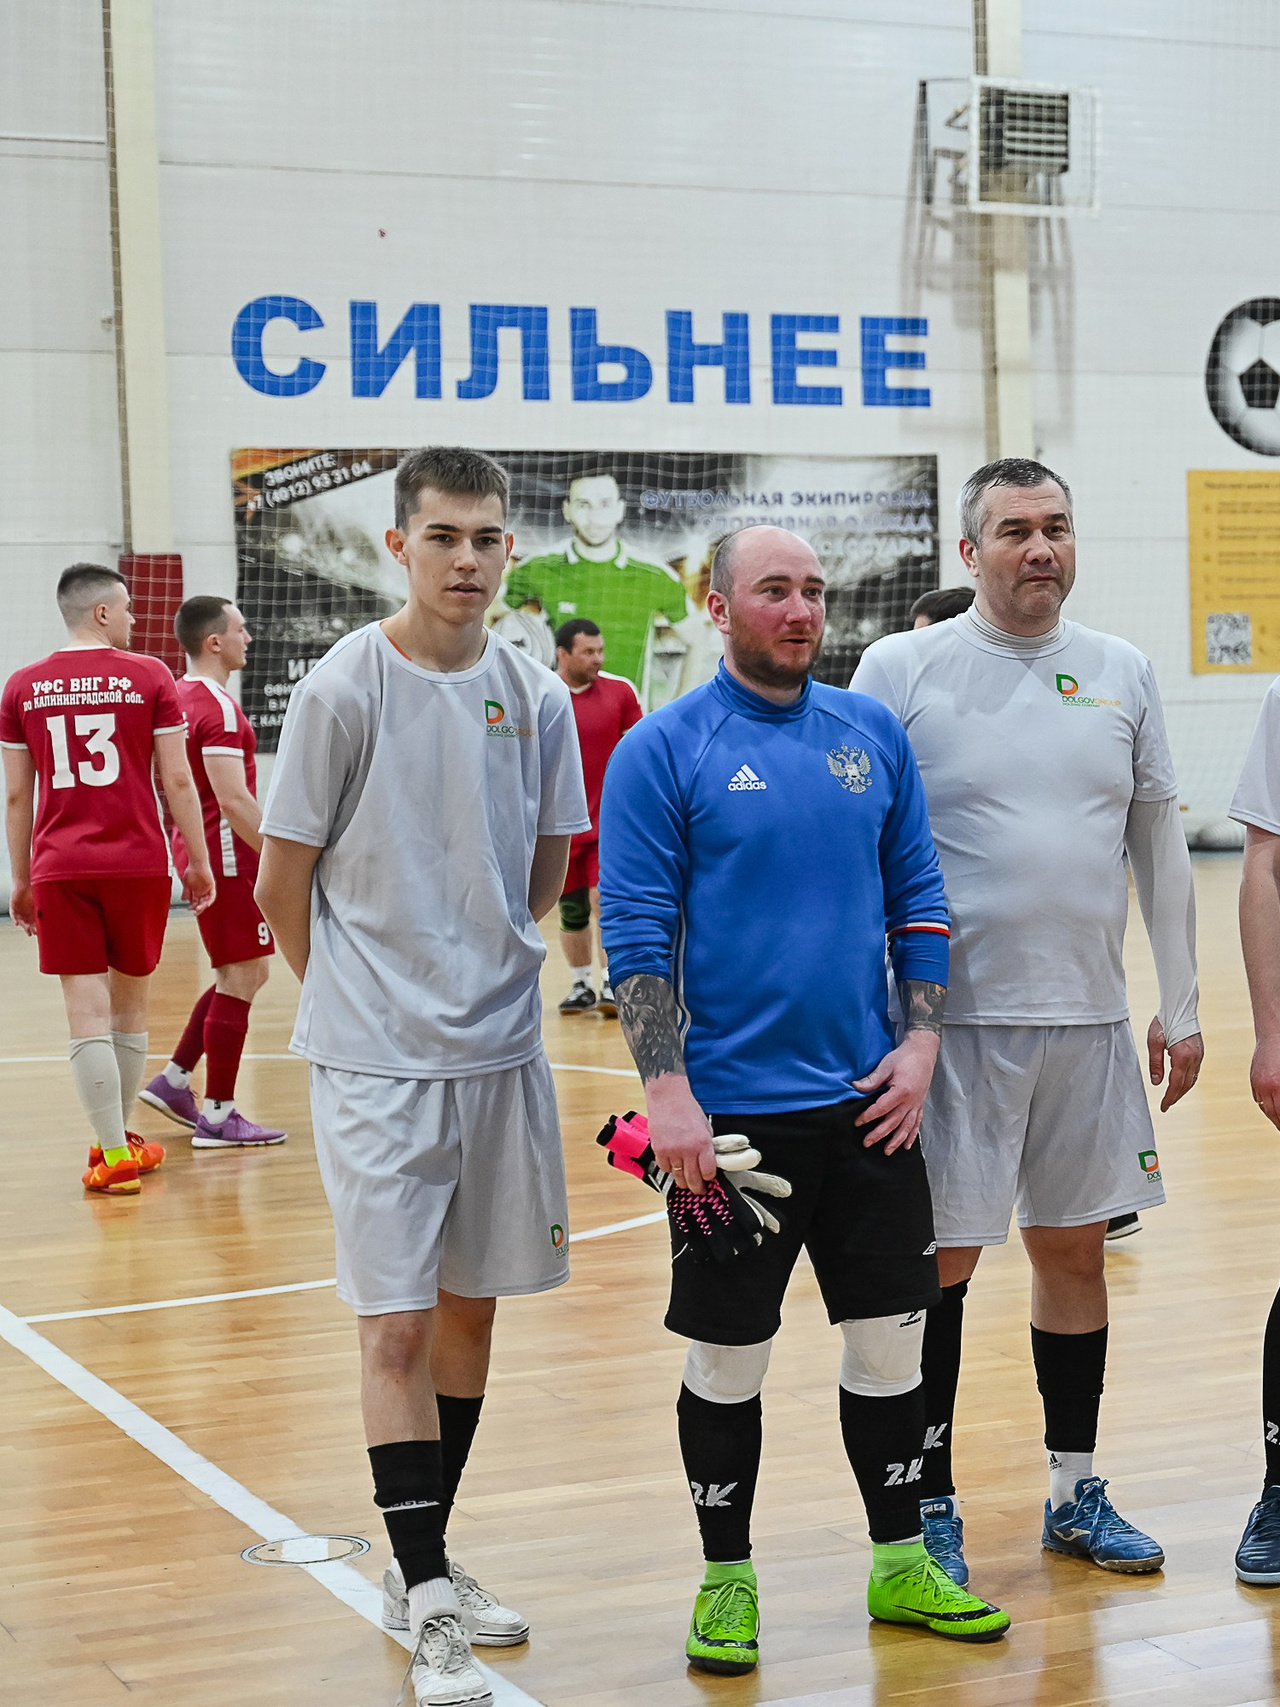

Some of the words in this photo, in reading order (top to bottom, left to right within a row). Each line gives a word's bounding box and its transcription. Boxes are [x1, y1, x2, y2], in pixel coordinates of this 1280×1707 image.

[231, 294, 932, 408] СИЛЬНЕЕ
[640, 489, 783, 510] ФУТБОЛЬНАЯ
[790, 490, 931, 508] ЭКИПИРОВКА
[32, 679, 64, 696] УФС
[70, 677, 103, 692] ВНГ
[108, 676, 132, 690] РФ
[33, 689, 122, 709] КАЛИНИНГРАДСКОЙ
[46, 713, 120, 789] 13
[728, 780, 767, 791] adidas
[257, 922, 270, 946] 9
[922, 1423, 948, 1449] K
